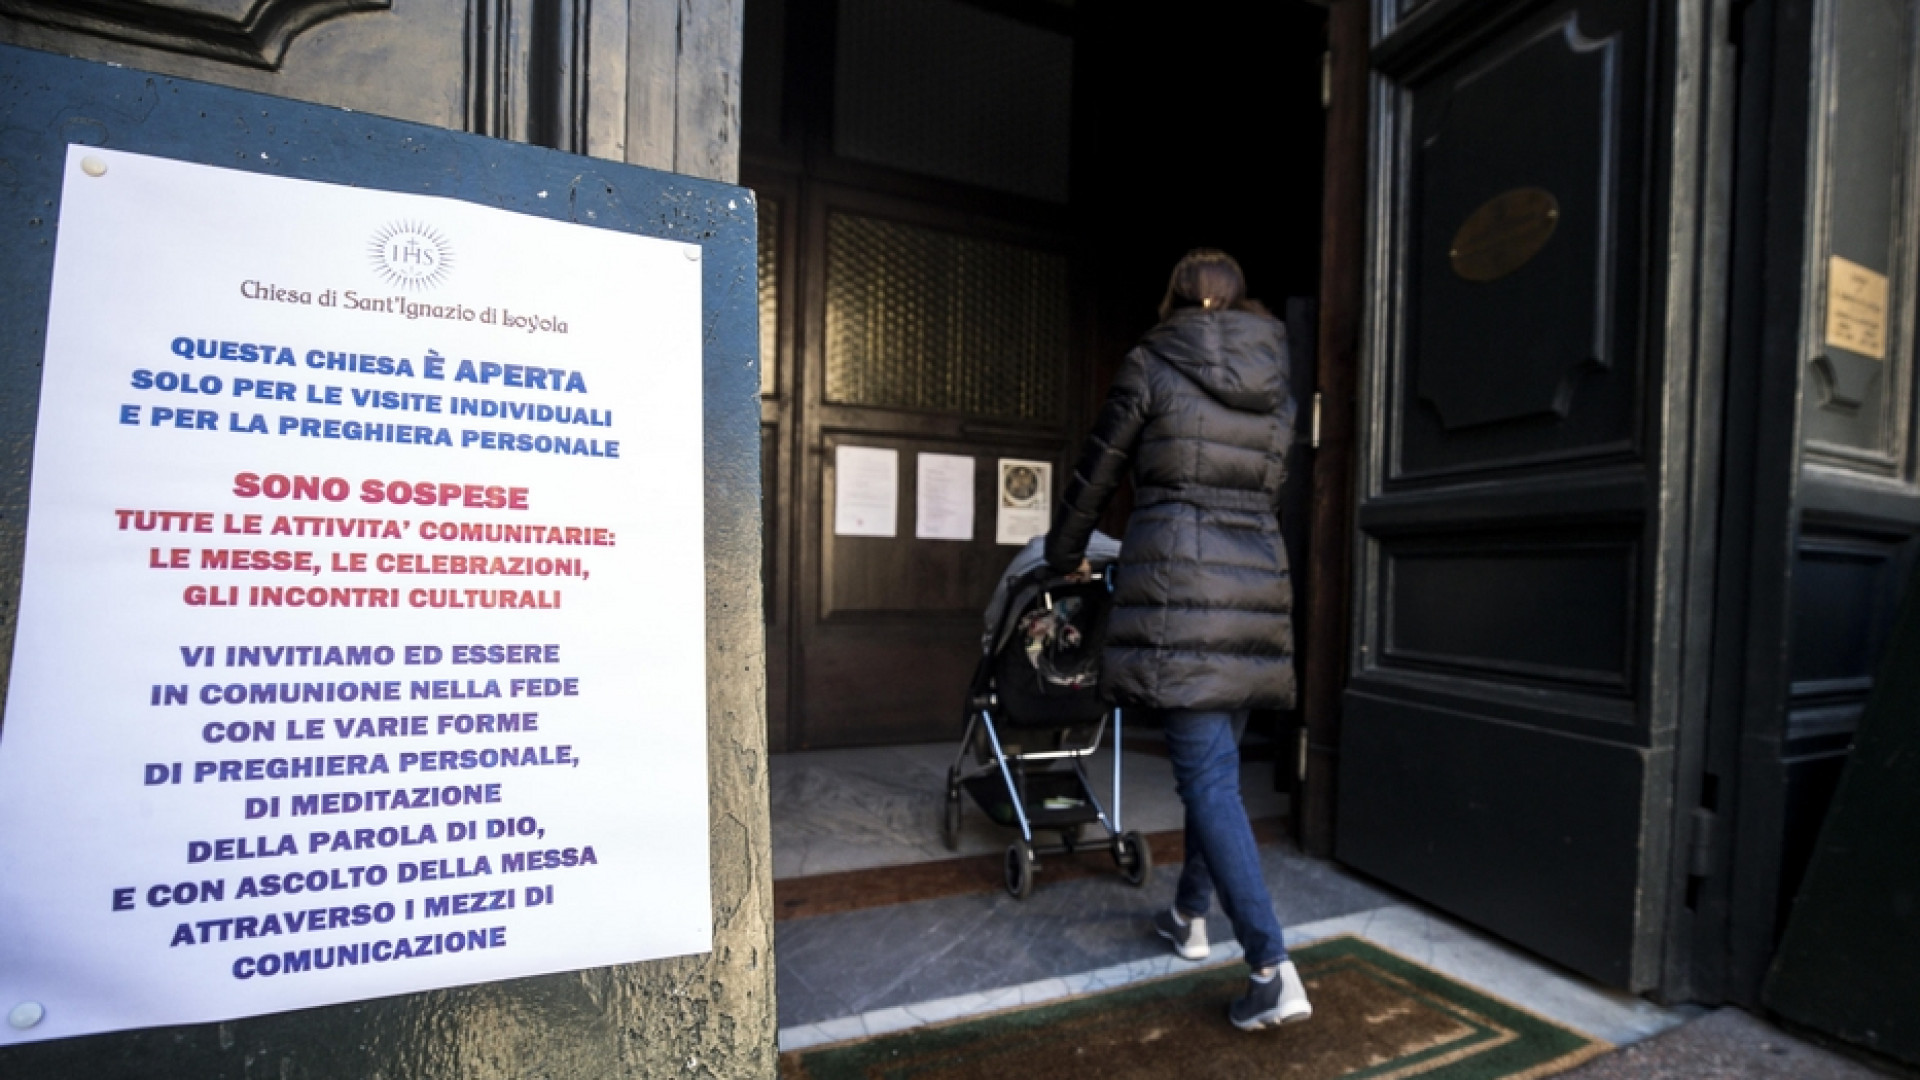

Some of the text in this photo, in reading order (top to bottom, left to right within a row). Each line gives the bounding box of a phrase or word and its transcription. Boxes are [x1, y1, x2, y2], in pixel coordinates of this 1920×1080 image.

[392, 243, 433, 266] IHS
[241, 280, 568, 333] Chiesa di Sant'Ignazio di Loyola
[171, 336, 587, 393] QUESTA CHIESA È APERTA
[130, 368, 612, 428] SOLO PER LE VISITE INDIVIDUALI
[119, 403, 620, 459] E PER LA PREGHIERA PERSONALE
[232, 471, 529, 510] SONO SOSPESE
[115, 509, 616, 547] TUTTE LE ATTIVITA' COMUNITARIE:
[150, 547, 589, 580] LE MESSE, LE CELEBRAZIONI,
[183, 584, 560, 609] GLI INCONTRI CULTURALI
[179, 644, 560, 667] VI INVITIAMO ED ESSERE
[150, 677, 579, 706] IN COMUNIONE NELLA FEDE
[202, 712, 539, 743] CON LE VARIE FORME
[144, 745, 579, 786] DI PREGHIERA PERSONALE,
[245, 782, 502, 819] DI MEDITAZIONE
[187, 816, 545, 864] DELLA PAROLA DI DIO,
[111, 845, 598, 912] E CON ASCOLTO DELLA MESSA
[169, 884, 554, 948] ATTRAVERSO I MEZZI DI
[232, 926, 506, 980] COMUNICAZIONE
